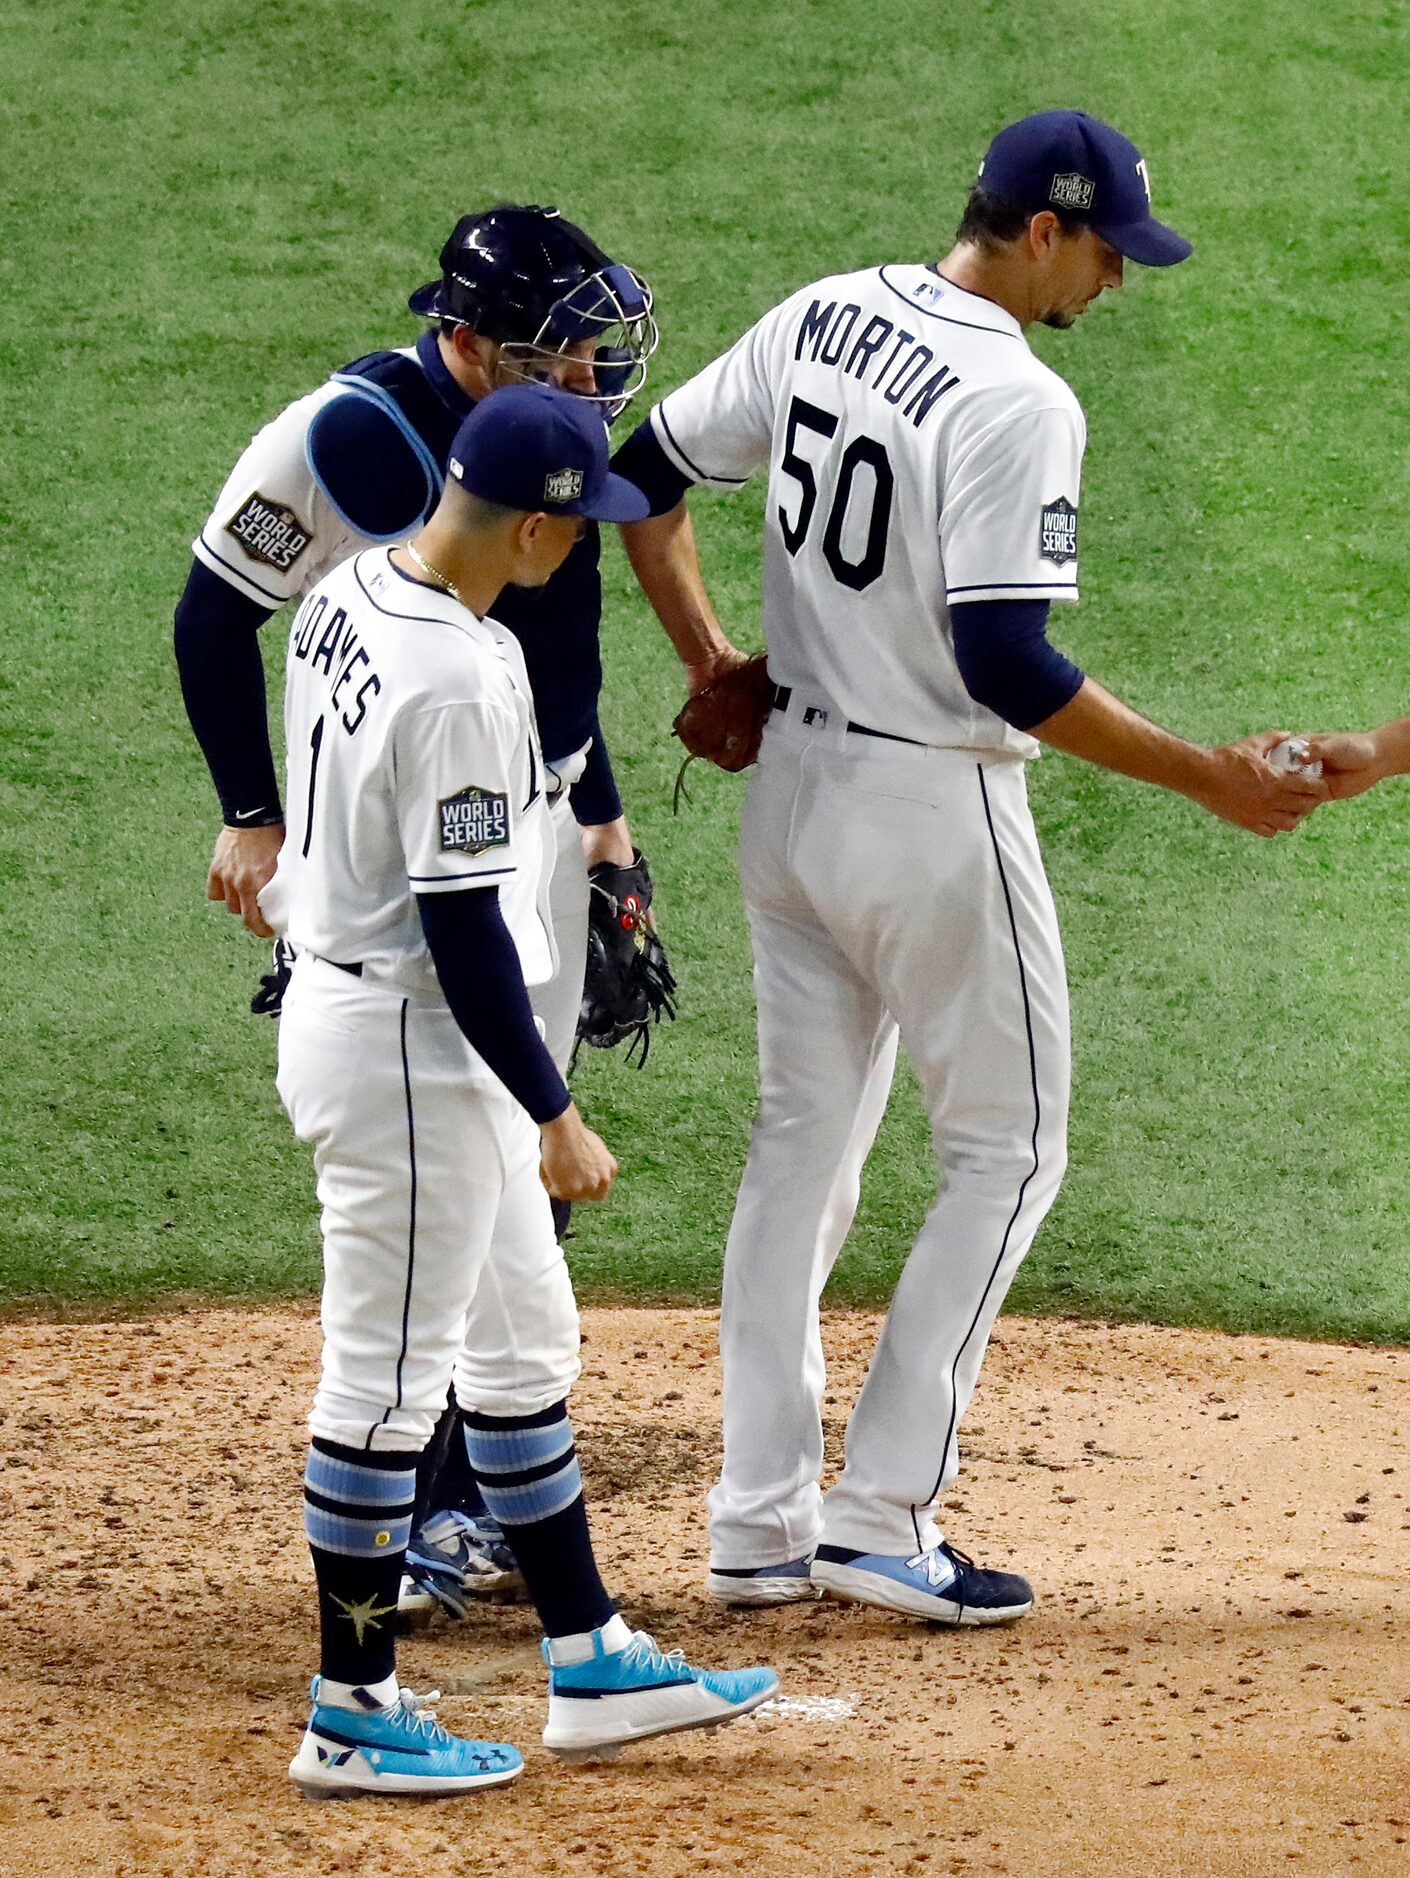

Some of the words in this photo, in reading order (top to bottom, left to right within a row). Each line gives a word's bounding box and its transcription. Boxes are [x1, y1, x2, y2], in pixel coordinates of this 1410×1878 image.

[1053, 187, 1089, 205] SERIES
[1056, 177, 1091, 195] WORLD
[795, 299, 961, 428] MORTON
[770, 394, 894, 592] 50
[246, 499, 307, 552] WORLD
[1043, 512, 1076, 533] WORLD
[232, 514, 297, 567] SERIES
[1042, 531, 1076, 554] SERIES
[302, 713, 324, 860] 1
[441, 799, 504, 824] WORLD
[442, 818, 506, 845] SERIES
